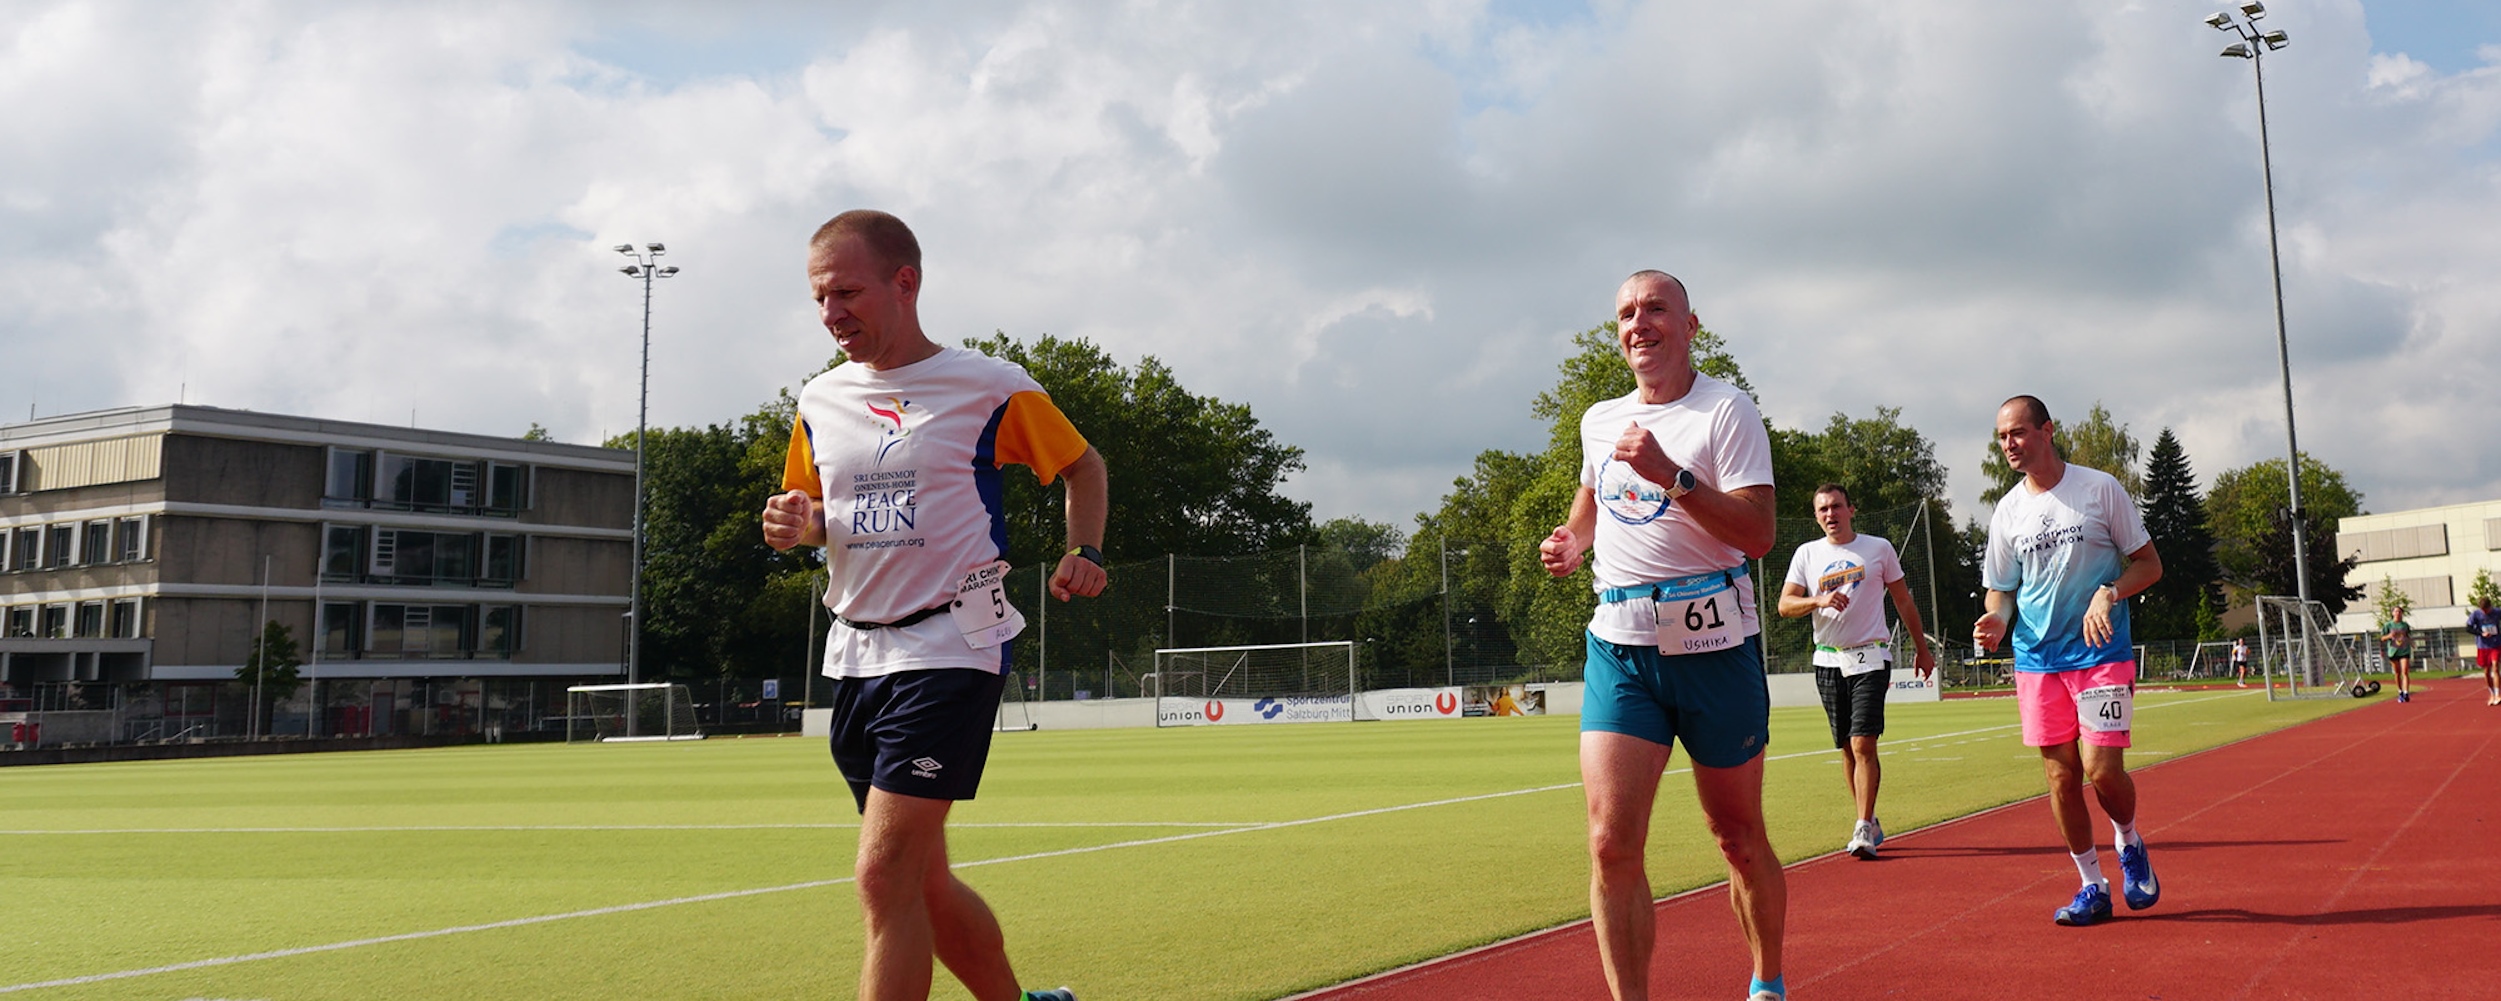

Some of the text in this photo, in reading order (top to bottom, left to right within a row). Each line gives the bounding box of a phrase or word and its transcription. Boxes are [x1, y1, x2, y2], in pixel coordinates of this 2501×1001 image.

[853, 470, 917, 483] SRI CHINMOY
[854, 480, 916, 492] ONENESS-HOME
[855, 489, 917, 509] PEACE
[851, 507, 917, 535] RUN
[845, 538, 925, 550] www.peacerun.org
[991, 588, 1004, 619] 5
[1684, 597, 1725, 631] 61
[1684, 636, 1728, 652] USHIKA
[1857, 651, 1866, 664] 2
[1286, 708, 1329, 720] Salzburg
[1387, 704, 1432, 714] union
[2099, 701, 2122, 720] 40
[1160, 711, 1202, 721] union
